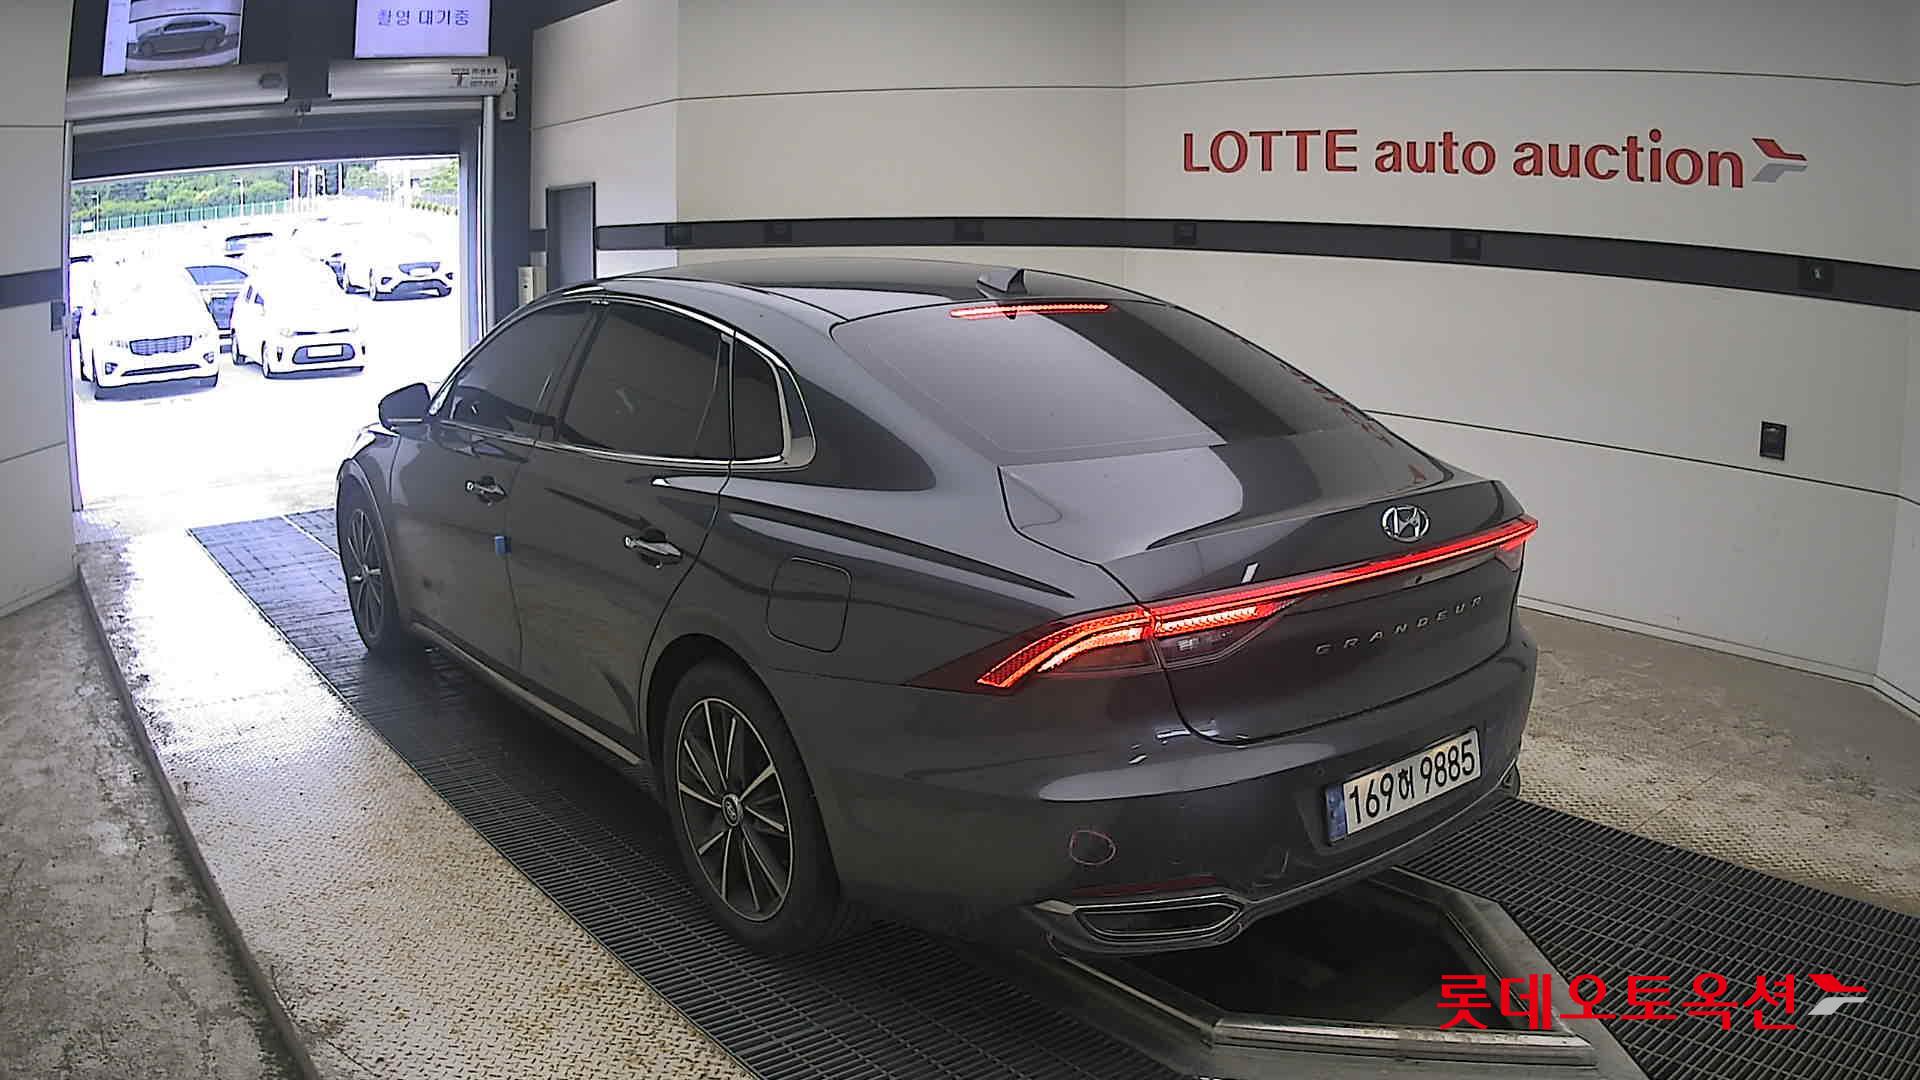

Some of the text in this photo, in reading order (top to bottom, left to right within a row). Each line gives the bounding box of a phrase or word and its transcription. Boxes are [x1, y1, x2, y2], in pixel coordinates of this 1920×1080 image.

[418, 9, 469, 26] 대기중
[1183, 128, 1745, 189] LOTTE auto auction
[1315, 596, 1482, 655] GRANDEUR
[1419, 739, 1476, 794] 9885
